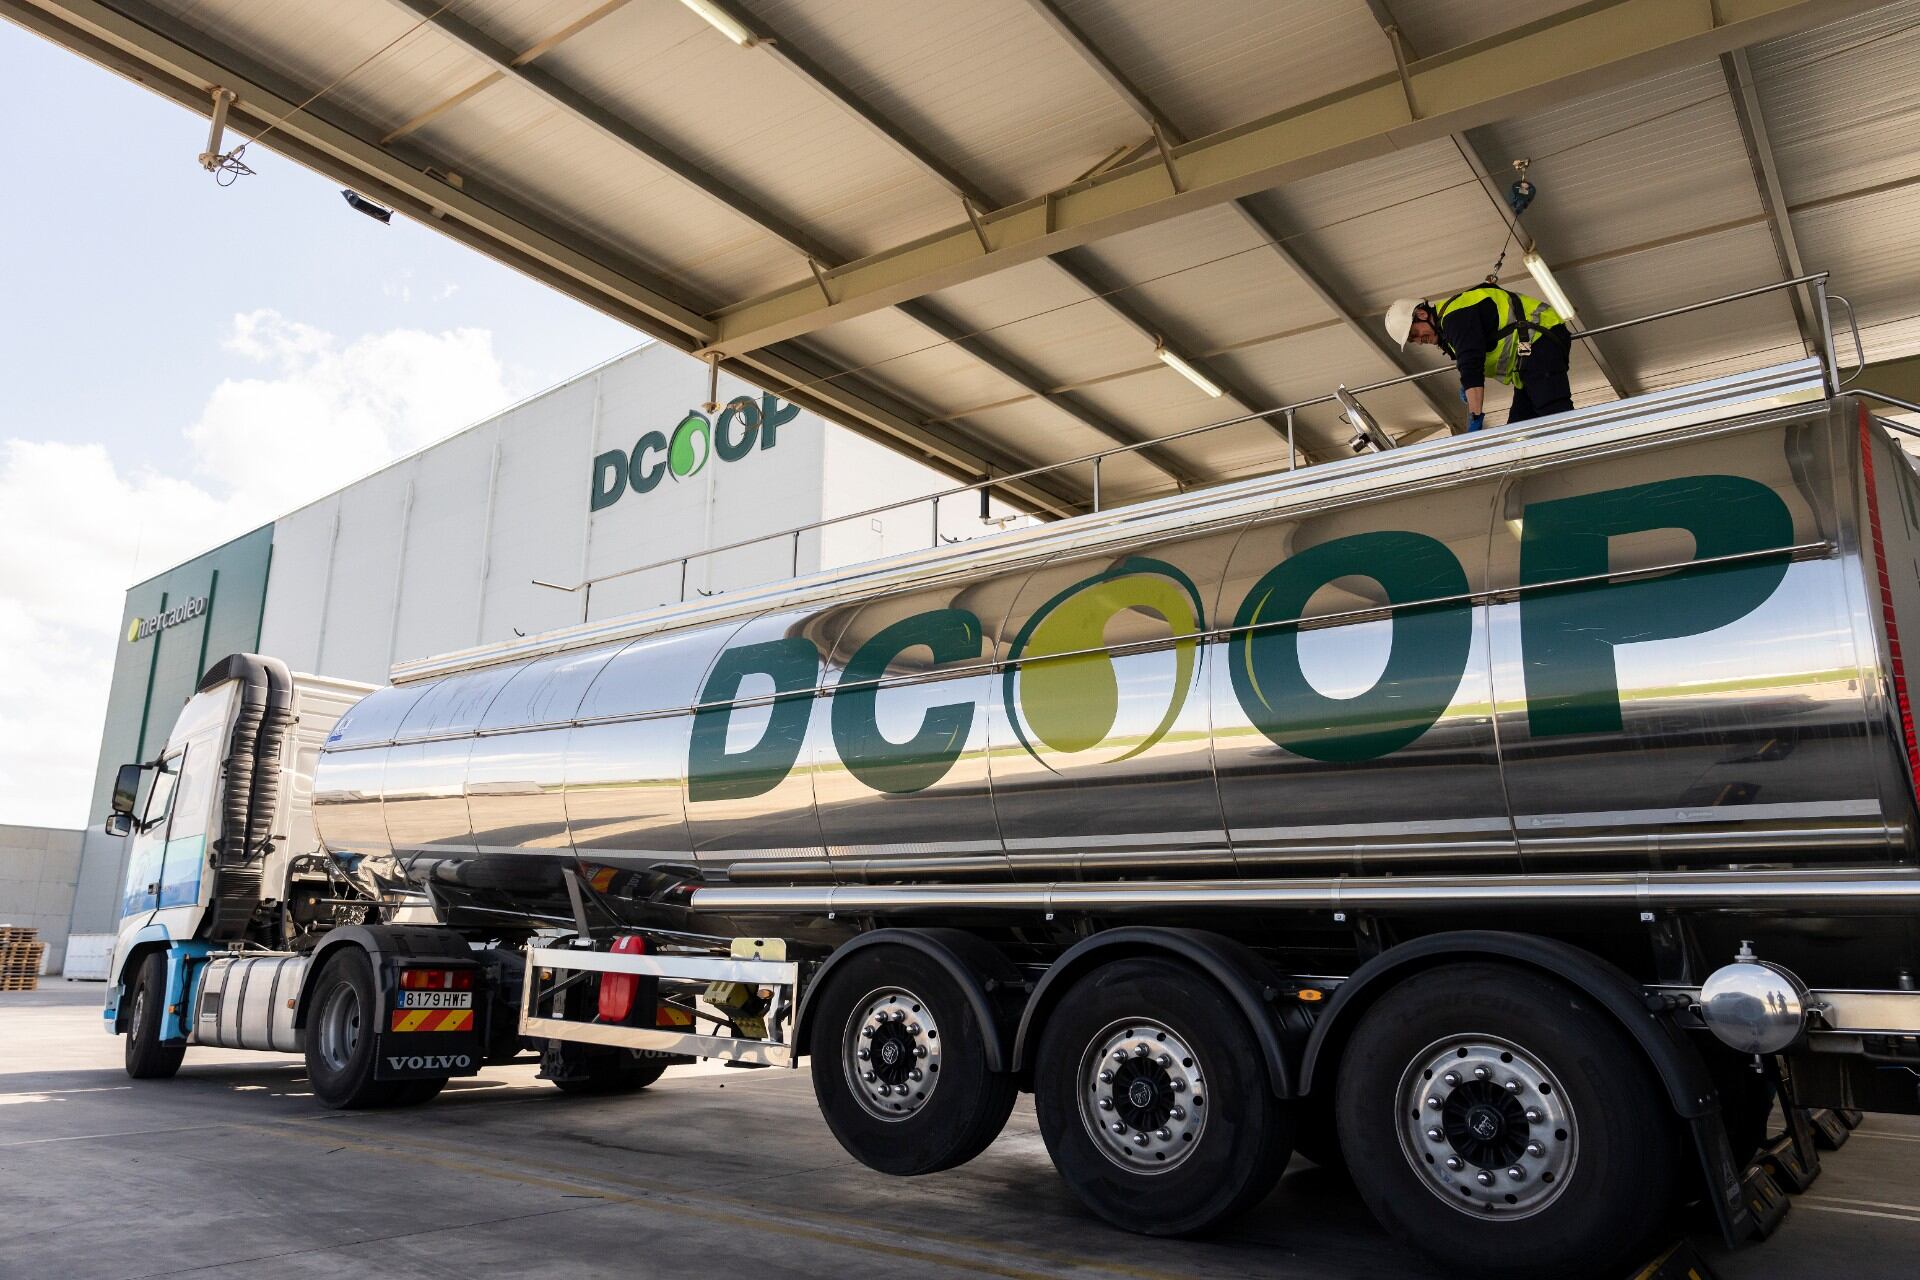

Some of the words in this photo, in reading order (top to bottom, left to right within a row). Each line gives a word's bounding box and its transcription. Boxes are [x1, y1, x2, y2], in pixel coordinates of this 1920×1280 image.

[688, 474, 1794, 803] DCOOP
[406, 992, 440, 1006] 8179
[443, 993, 469, 1007] HWF
[387, 1054, 471, 1070] VOLVO
